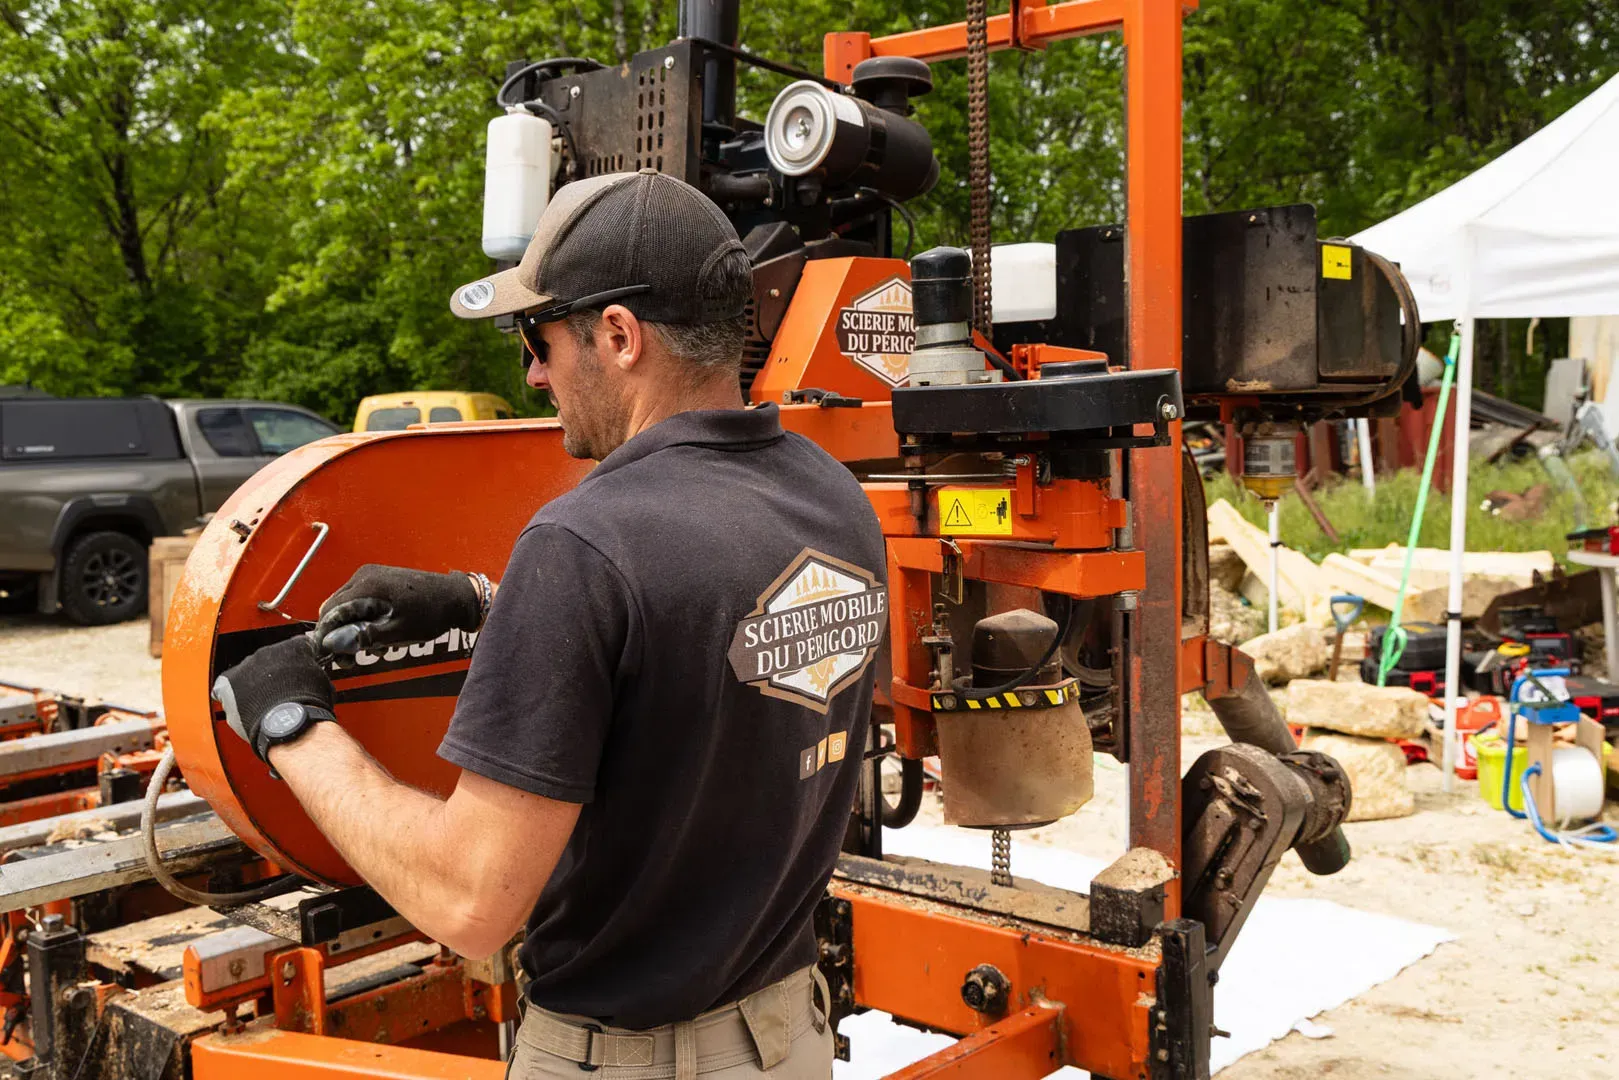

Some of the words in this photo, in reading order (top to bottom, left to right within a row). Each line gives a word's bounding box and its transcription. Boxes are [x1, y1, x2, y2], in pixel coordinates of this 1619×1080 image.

[842, 312, 895, 331] SCIERIE
[848, 333, 869, 351] DU
[872, 329, 917, 353] PÉRIG
[744, 606, 818, 648] SCIERIE
[820, 592, 886, 627] MOBILE
[756, 644, 790, 676] DU
[796, 620, 879, 665] PÉRIGORD
